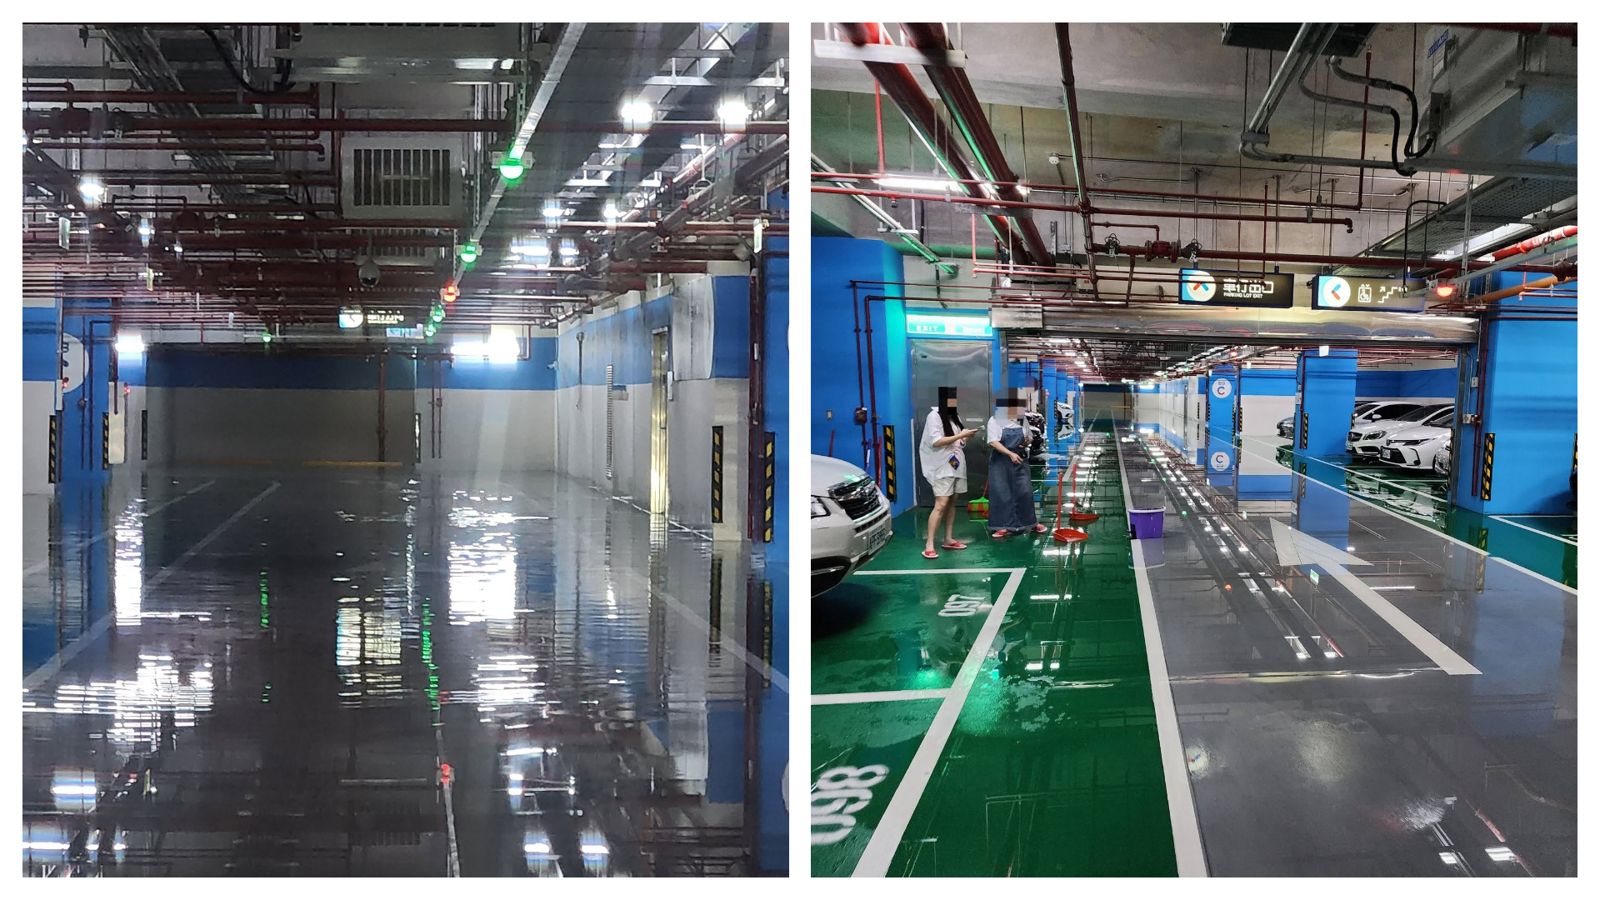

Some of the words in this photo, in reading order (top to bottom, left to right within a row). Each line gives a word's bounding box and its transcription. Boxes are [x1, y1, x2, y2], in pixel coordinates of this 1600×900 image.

[916, 324, 938, 332] EXIT
[1217, 386, 1225, 396] C
[938, 594, 986, 617] 097
[811, 764, 890, 846] 098
